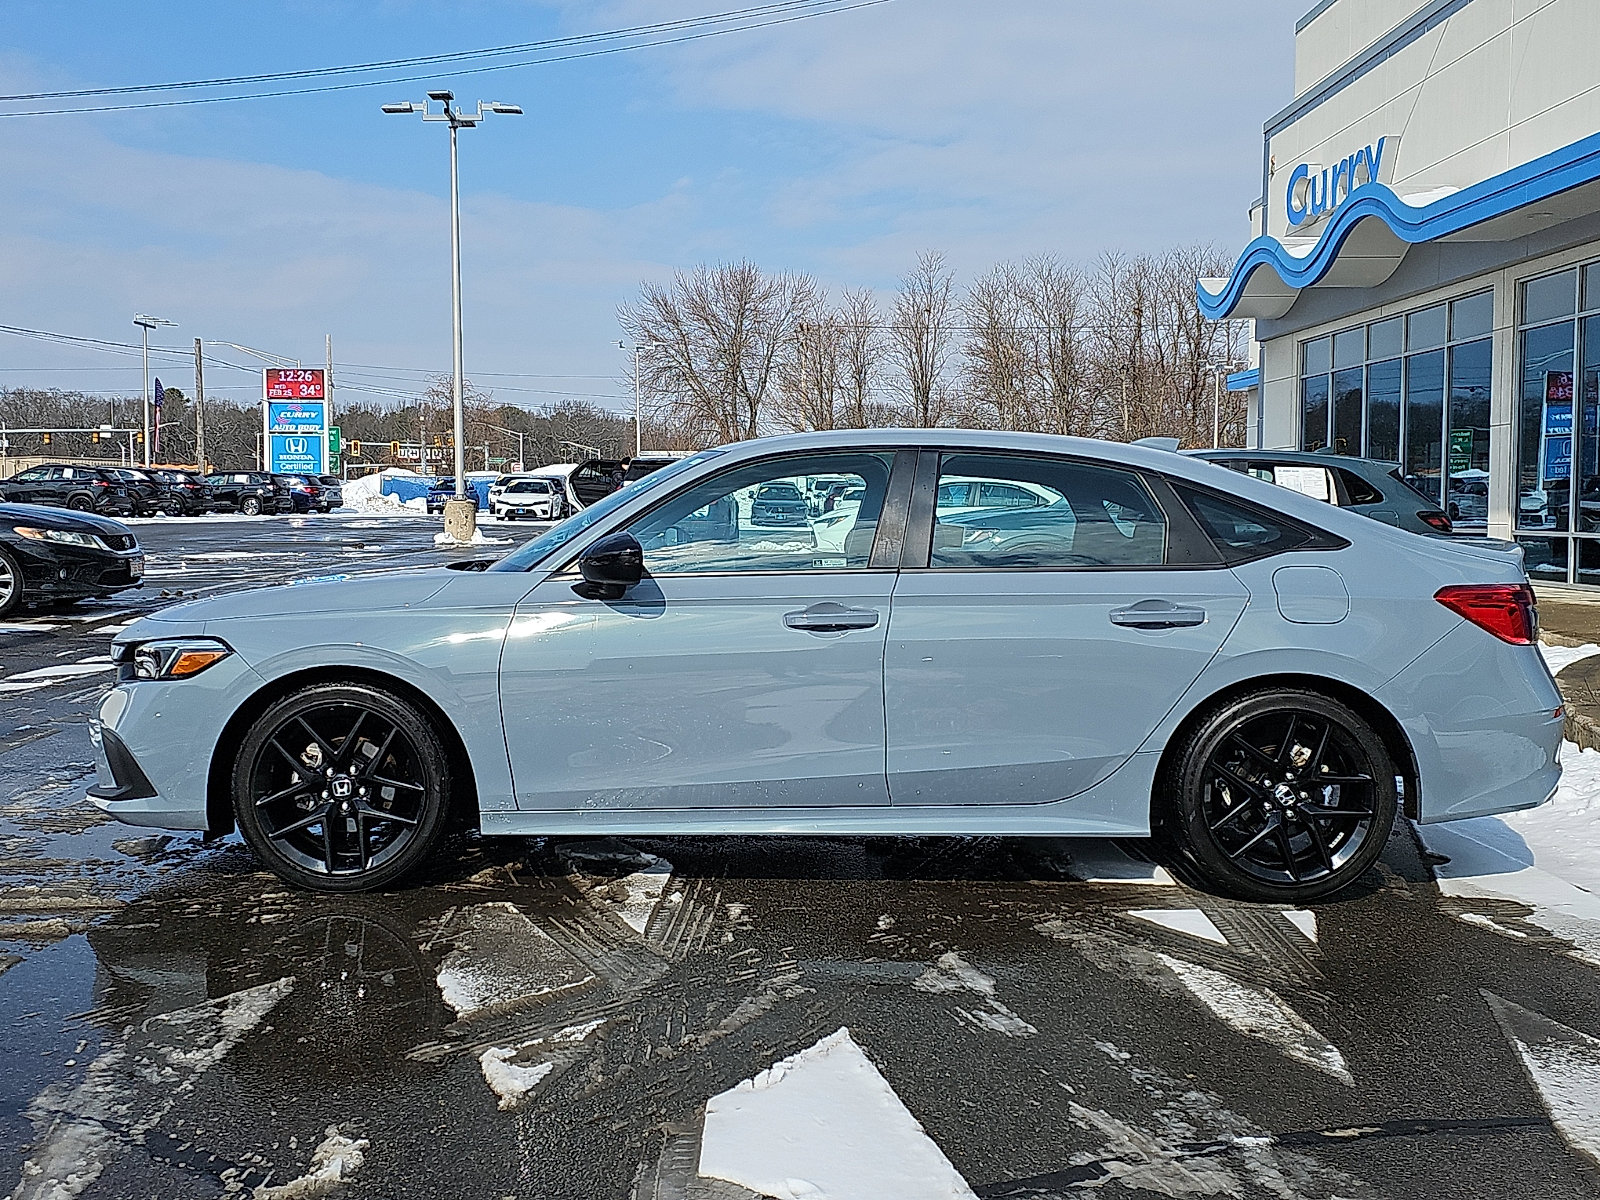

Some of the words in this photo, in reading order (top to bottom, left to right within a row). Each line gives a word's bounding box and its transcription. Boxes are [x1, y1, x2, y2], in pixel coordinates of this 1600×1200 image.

[1286, 135, 1386, 226] Curry
[279, 370, 312, 381] 12:26
[280, 462, 314, 471] Certified
